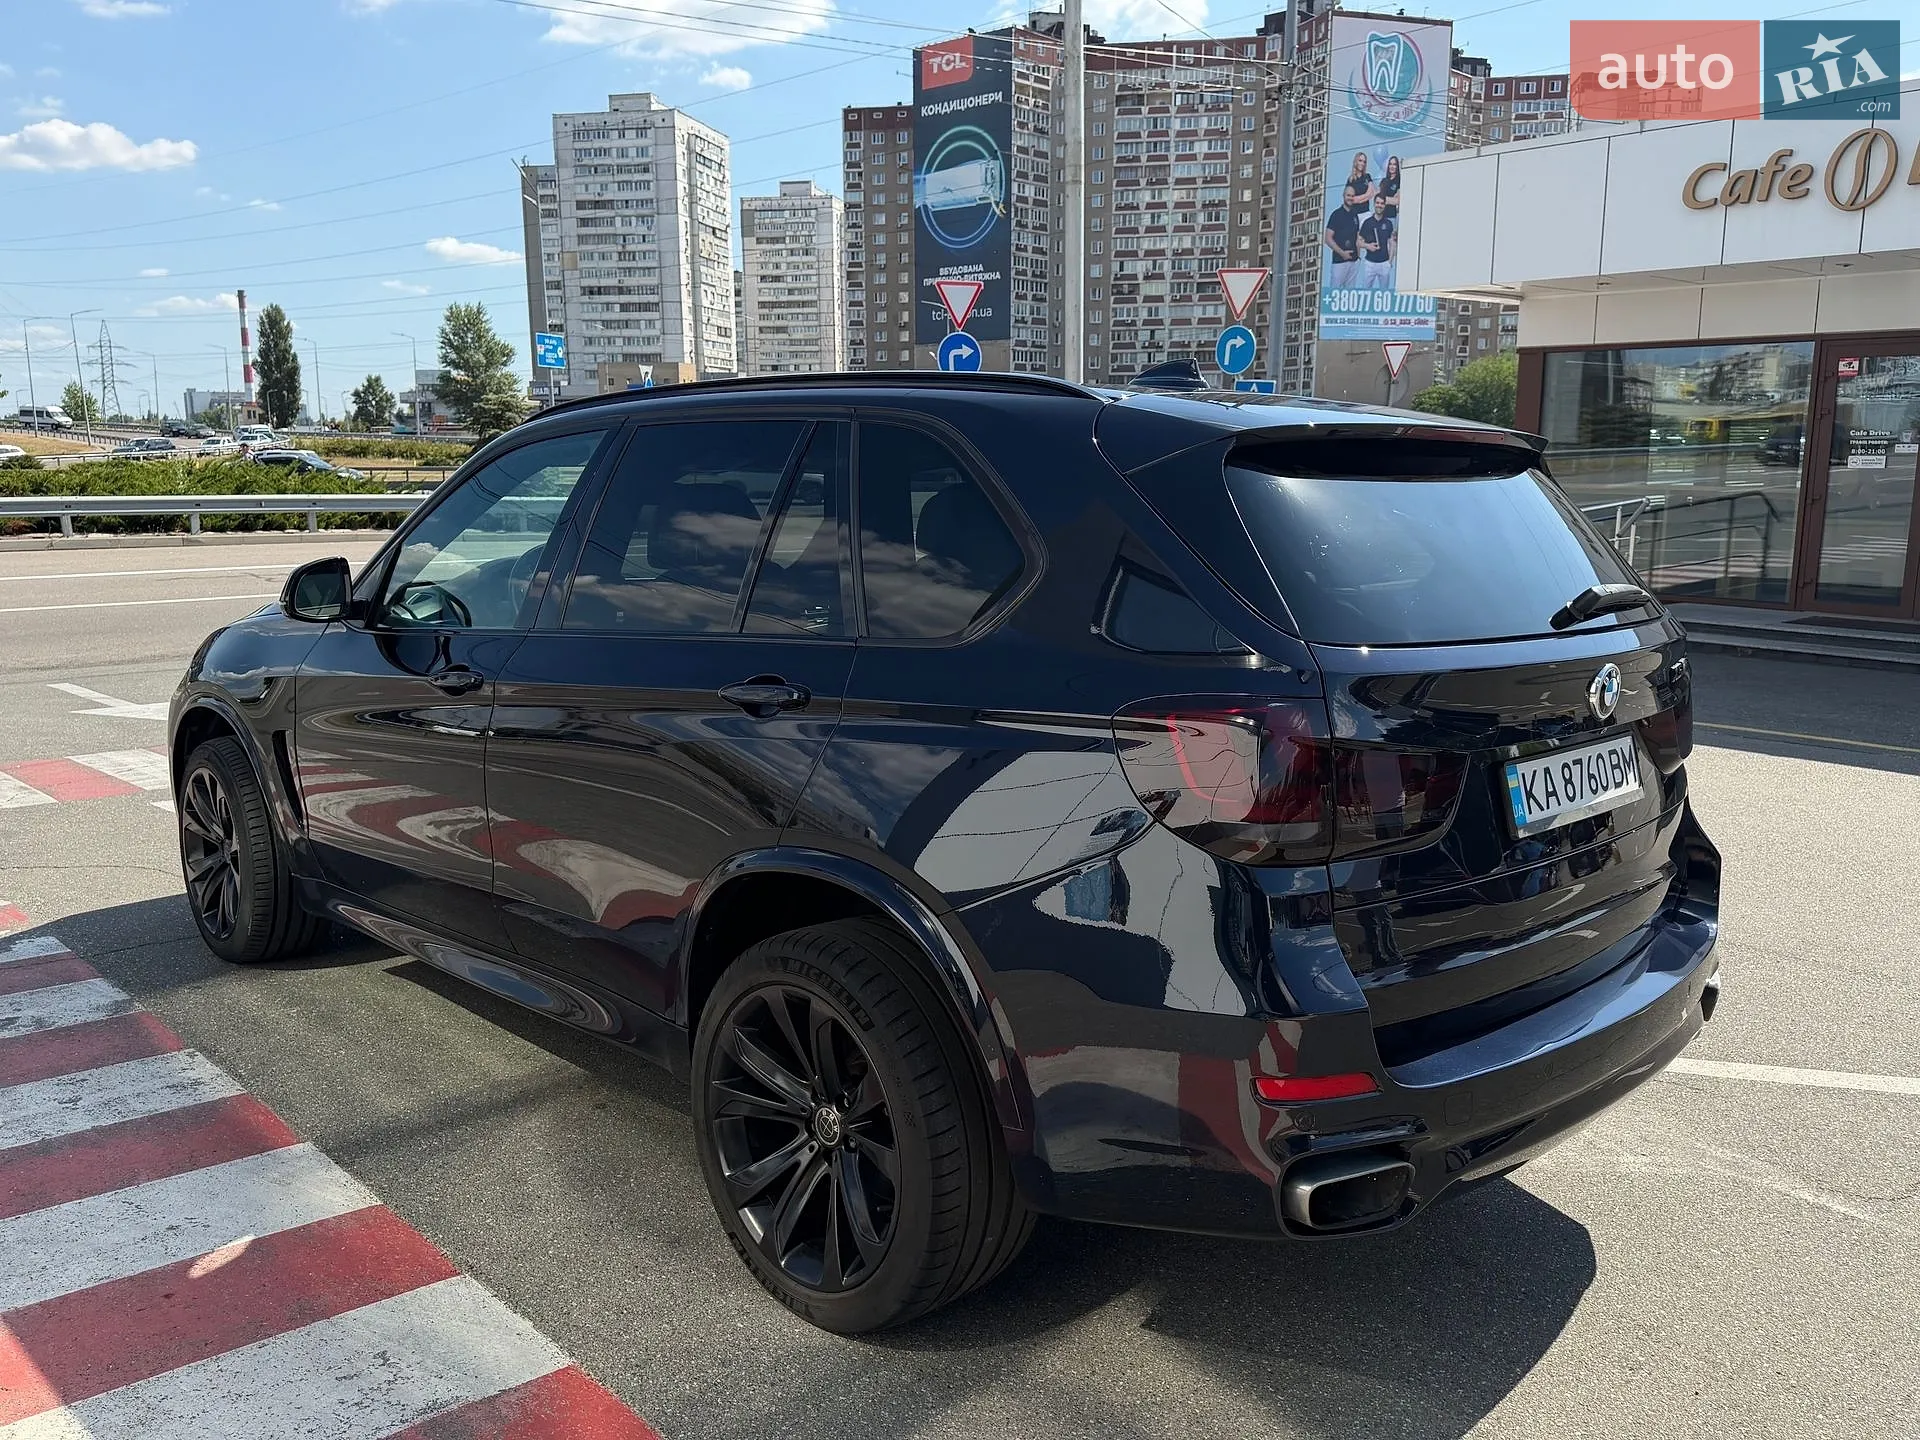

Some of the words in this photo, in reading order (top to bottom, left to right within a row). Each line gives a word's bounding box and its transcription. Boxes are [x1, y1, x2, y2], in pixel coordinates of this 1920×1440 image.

[928, 52, 967, 75] TCL
[921, 91, 1003, 117] КОНДИЦІОНЕРИ
[1682, 148, 1814, 211] Cafe
[939, 264, 984, 276] ВБУДОВАНА
[1322, 289, 1371, 312] +38077
[1373, 291, 1391, 313] 60
[1521, 766, 1562, 815] KA
[1561, 752, 1609, 803] 8760
[1609, 744, 1638, 790] BM
[1512, 803, 1526, 819] UA
